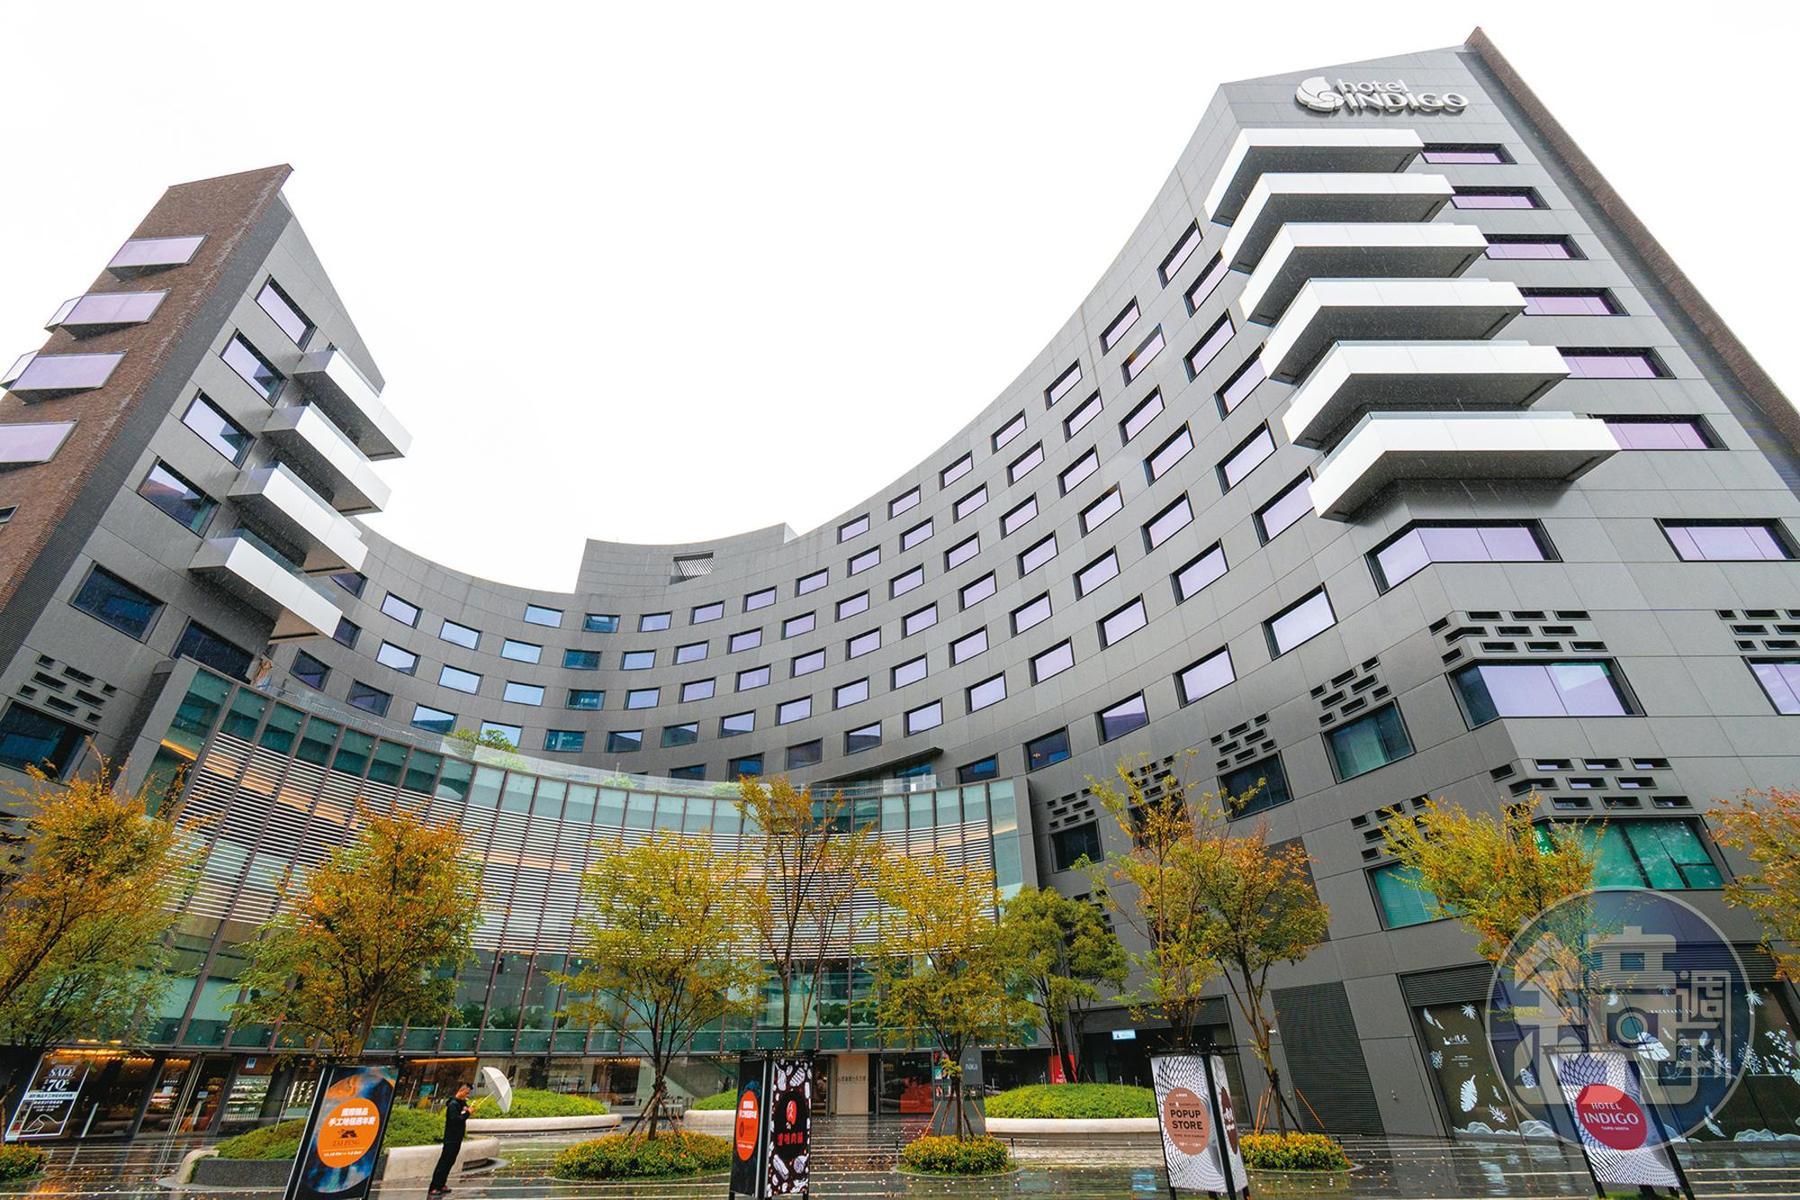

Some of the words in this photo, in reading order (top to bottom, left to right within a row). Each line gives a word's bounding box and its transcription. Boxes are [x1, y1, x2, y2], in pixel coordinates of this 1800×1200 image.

[1337, 79, 1408, 95] hotel
[1343, 92, 1469, 113] INDIGO
[49, 1068, 73, 1077] SALE
[1170, 1110, 1201, 1118] POPUP
[1584, 1113, 1639, 1125] INDIGO
[1172, 1121, 1203, 1130] STORE
